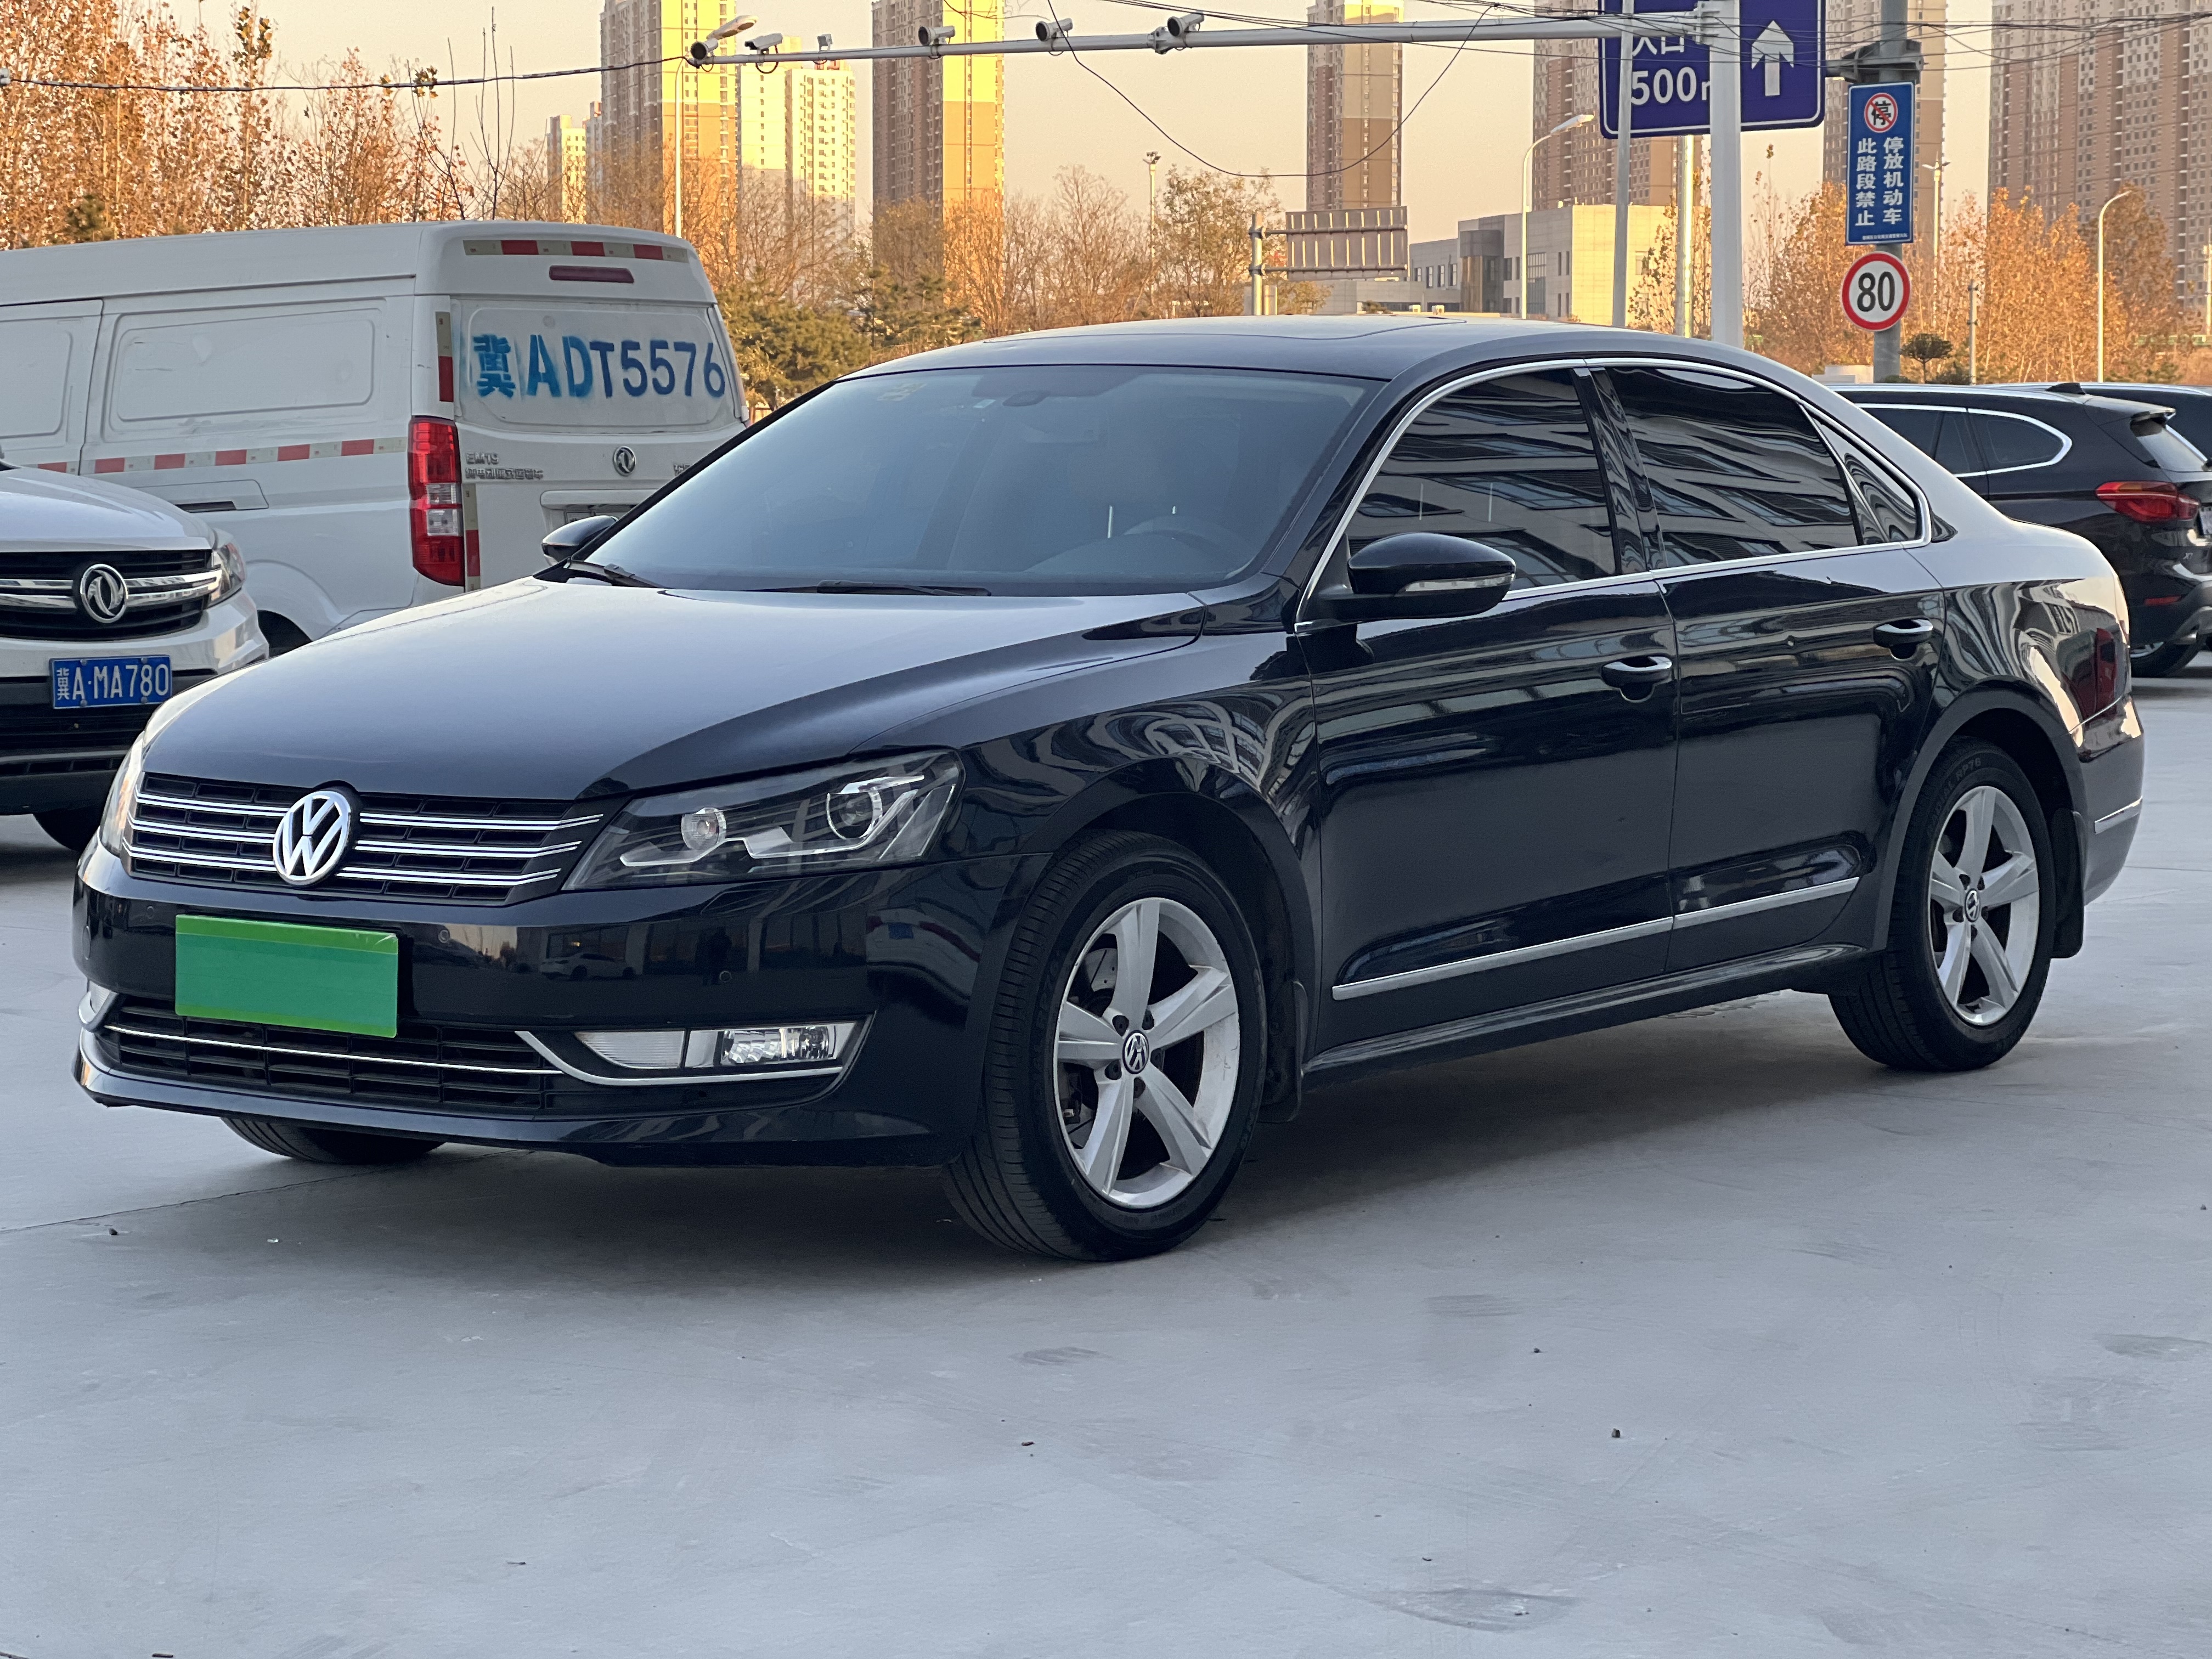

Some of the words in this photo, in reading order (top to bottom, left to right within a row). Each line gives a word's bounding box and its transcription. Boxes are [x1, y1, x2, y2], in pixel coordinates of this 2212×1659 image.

[1855, 138, 1877, 226] 此路段禁止
[1883, 137, 1904, 225] 停放机动车
[1857, 271, 1895, 312] 80
[473, 334, 725, 399] 冀ADT5576
